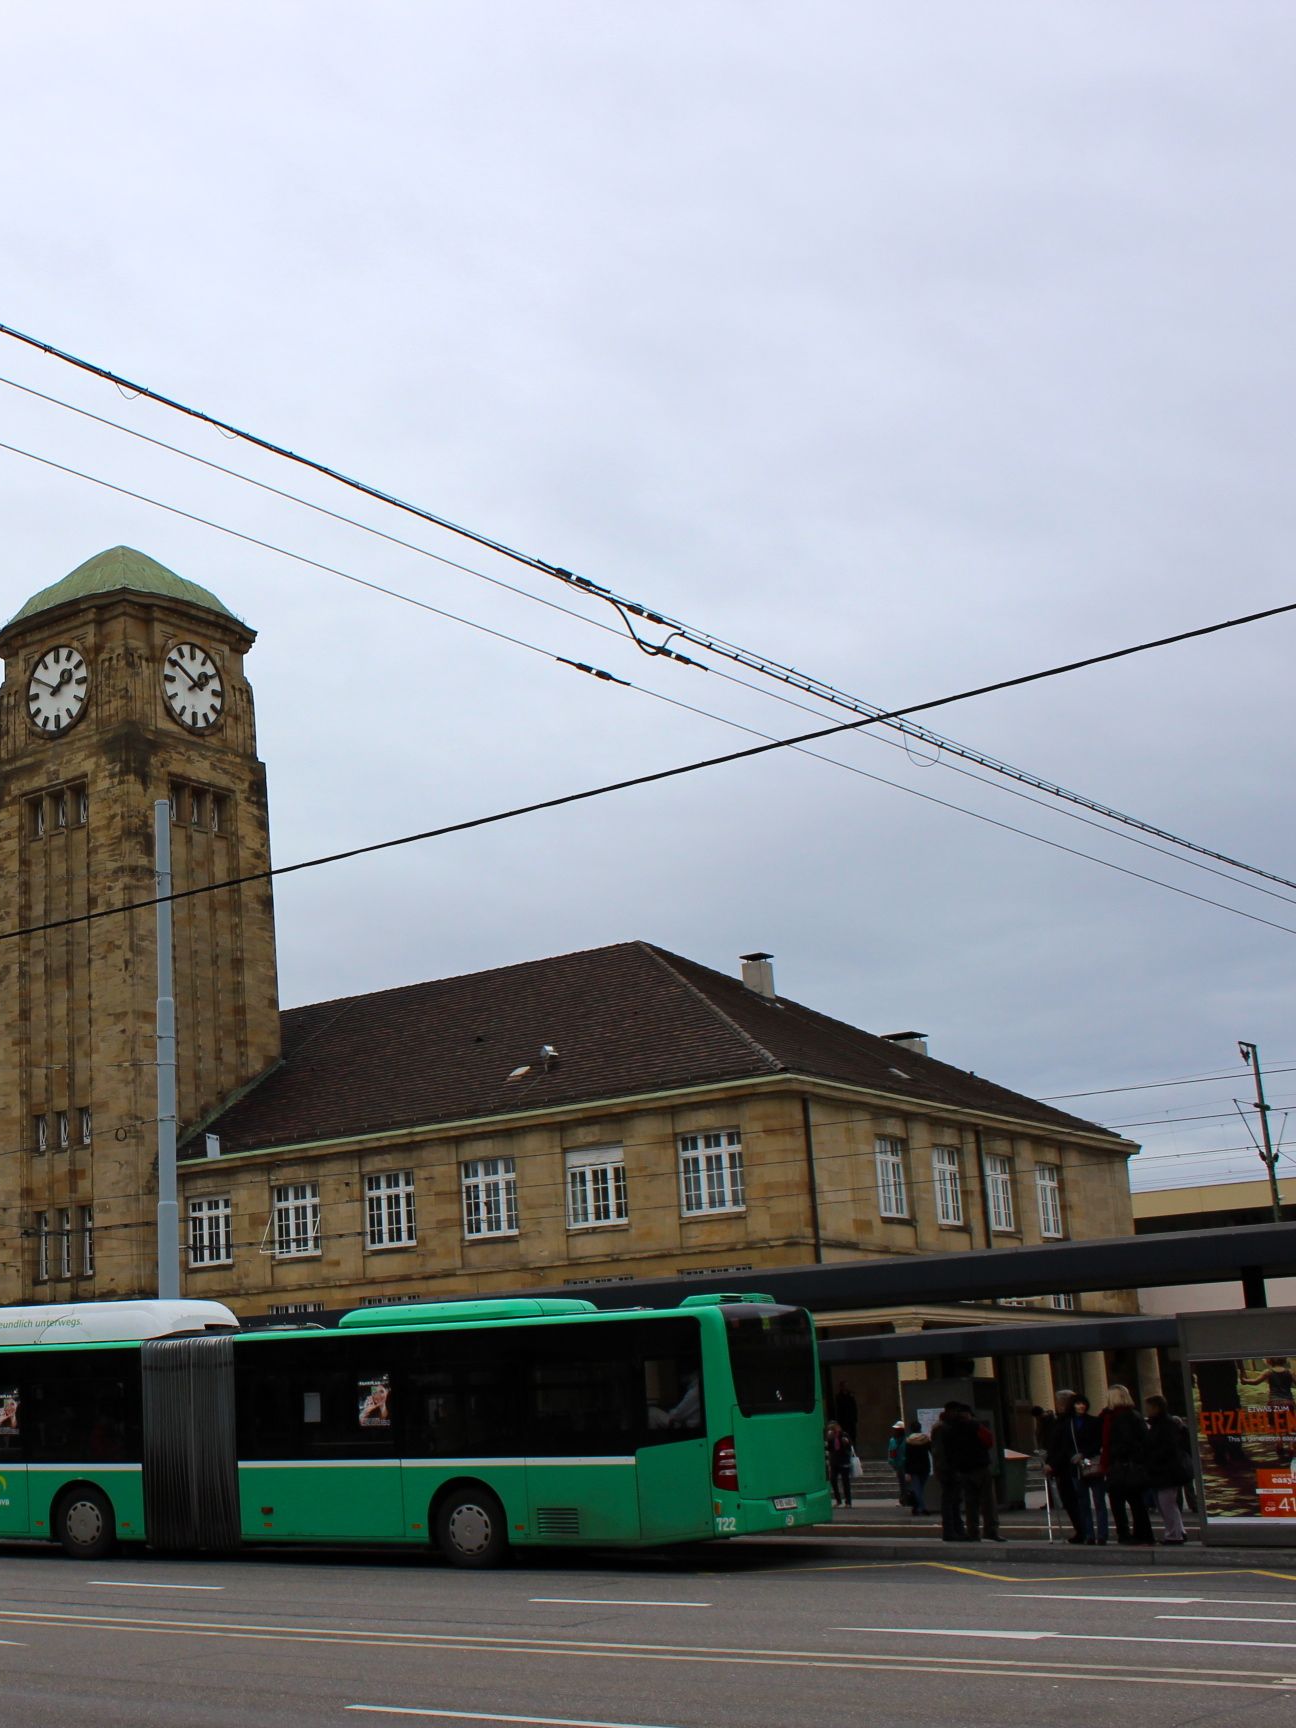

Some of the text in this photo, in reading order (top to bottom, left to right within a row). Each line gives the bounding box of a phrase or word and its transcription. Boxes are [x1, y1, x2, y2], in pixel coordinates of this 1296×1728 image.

[35, 1318, 83, 1328] unterwegs.
[1247, 1405, 1272, 1413] ETWAS
[716, 1517, 737, 1531] 722
